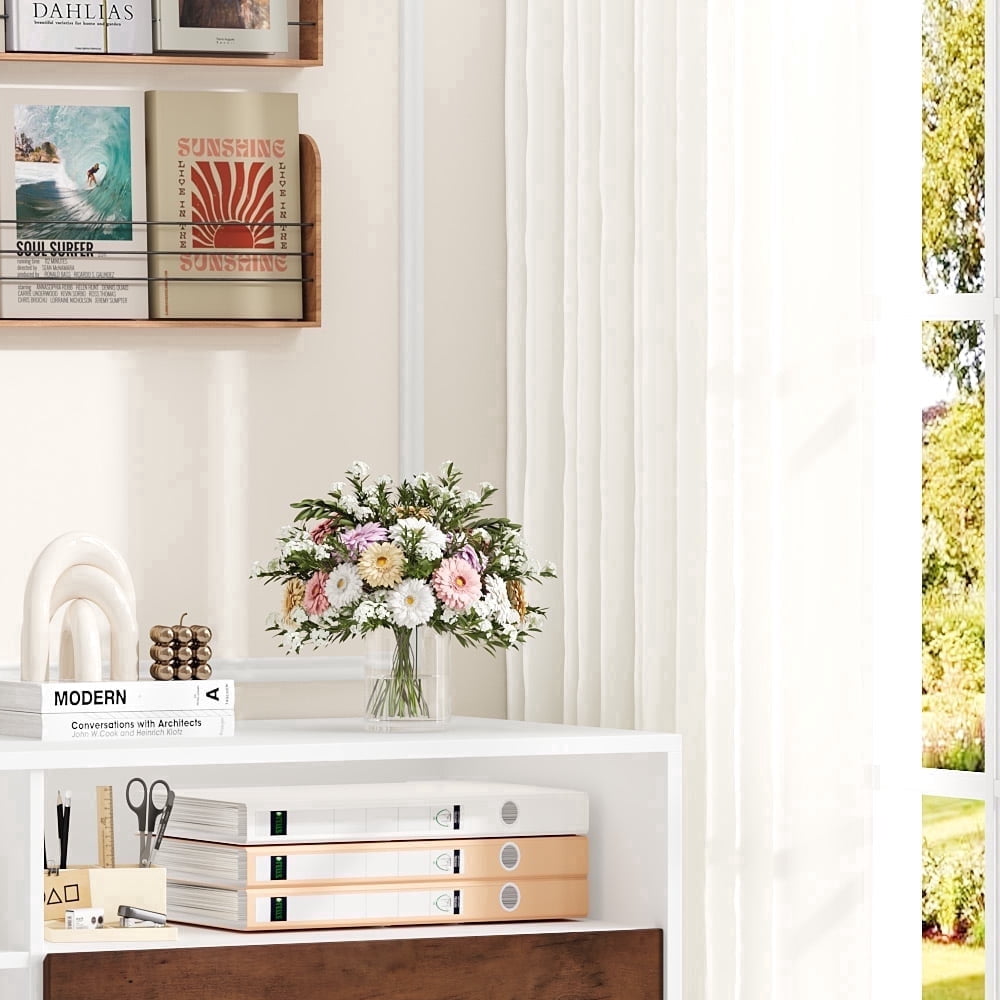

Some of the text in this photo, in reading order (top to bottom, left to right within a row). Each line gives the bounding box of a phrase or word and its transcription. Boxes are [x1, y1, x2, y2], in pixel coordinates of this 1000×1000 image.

[32, 2, 134, 20] DAHLIAS
[177, 137, 286, 159] SUNSHINE
[178, 160, 186, 196] LIVE
[179, 200, 186, 218] IN
[280, 202, 287, 219] IN
[16, 241, 94, 257] SOUL SURFER
[179, 253, 288, 272] SUNSHINE
[53, 689, 127, 706] MODERN
[205, 687, 220, 701] A
[71, 718, 202, 730] Conversations with Architects
[71, 730, 89, 738] John
